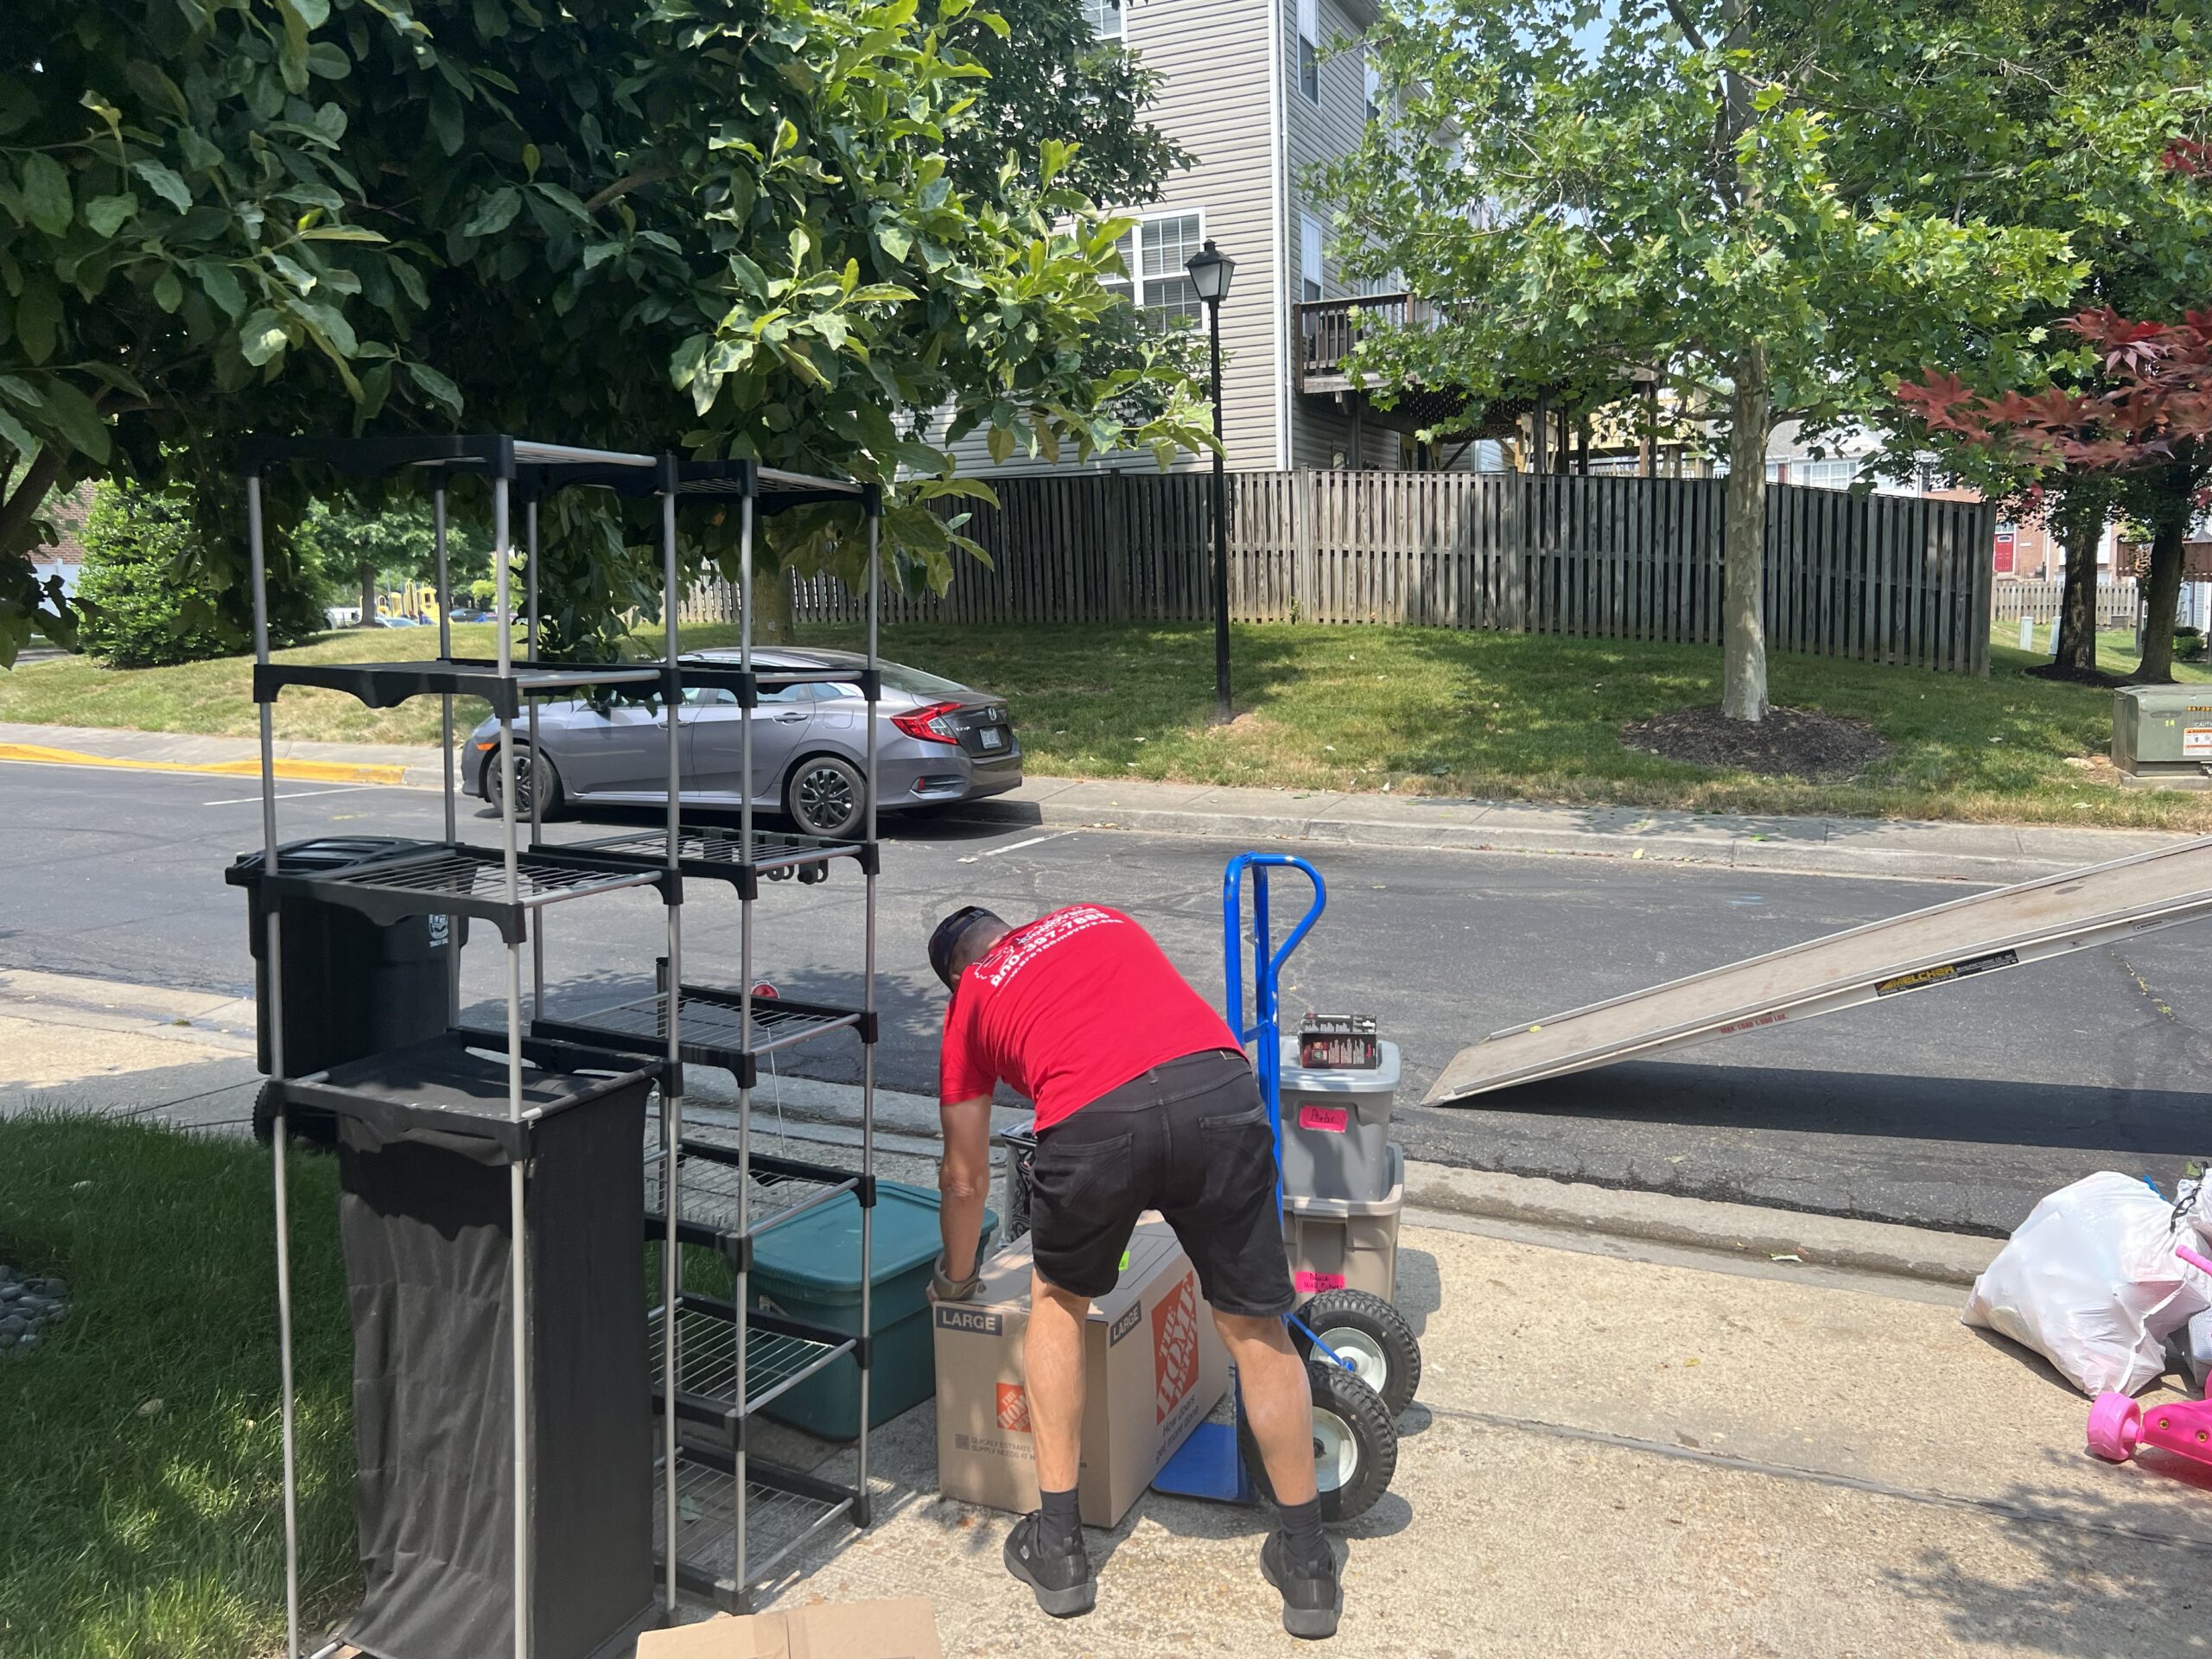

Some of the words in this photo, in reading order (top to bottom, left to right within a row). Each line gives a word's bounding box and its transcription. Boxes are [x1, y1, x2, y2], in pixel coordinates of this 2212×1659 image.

[1738, 1021, 1754, 1030] LOAD
[942, 1310, 996, 1332] LARGE
[1113, 1306, 1139, 1340] LARGE
[1157, 1277, 1193, 1414] HOME
[998, 1393, 1028, 1428] HOM
[1000, 1442, 1031, 1452] ESTIMATE
